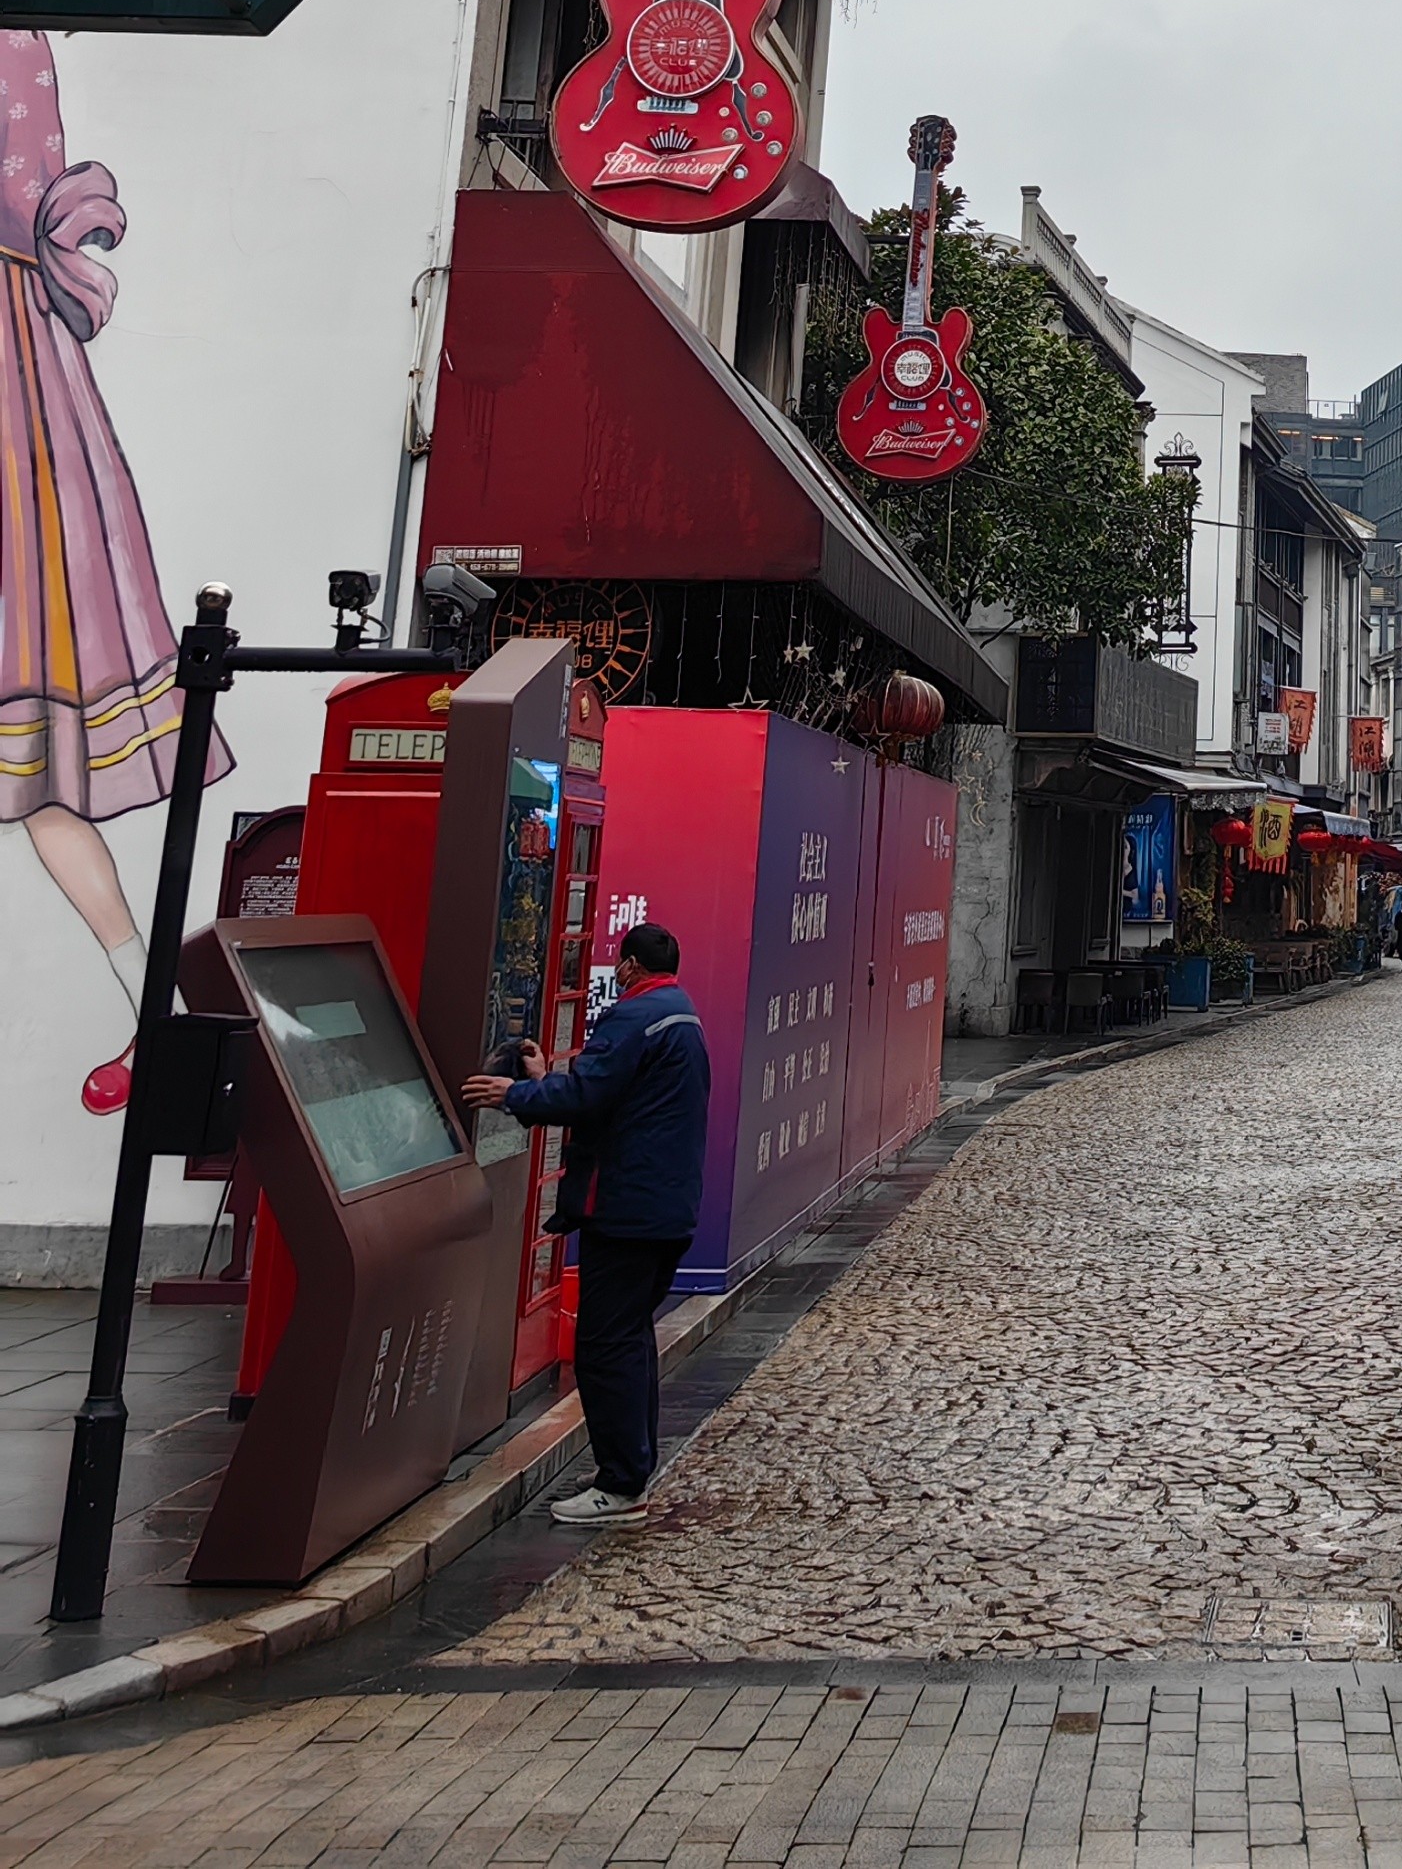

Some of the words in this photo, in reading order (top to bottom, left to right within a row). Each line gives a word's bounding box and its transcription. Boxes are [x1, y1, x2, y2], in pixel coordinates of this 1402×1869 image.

[605, 150, 729, 178] Budweiser
[873, 434, 947, 451] Budweiser
[355, 731, 447, 762] TELEP
[799, 831, 828, 882] 社会主义
